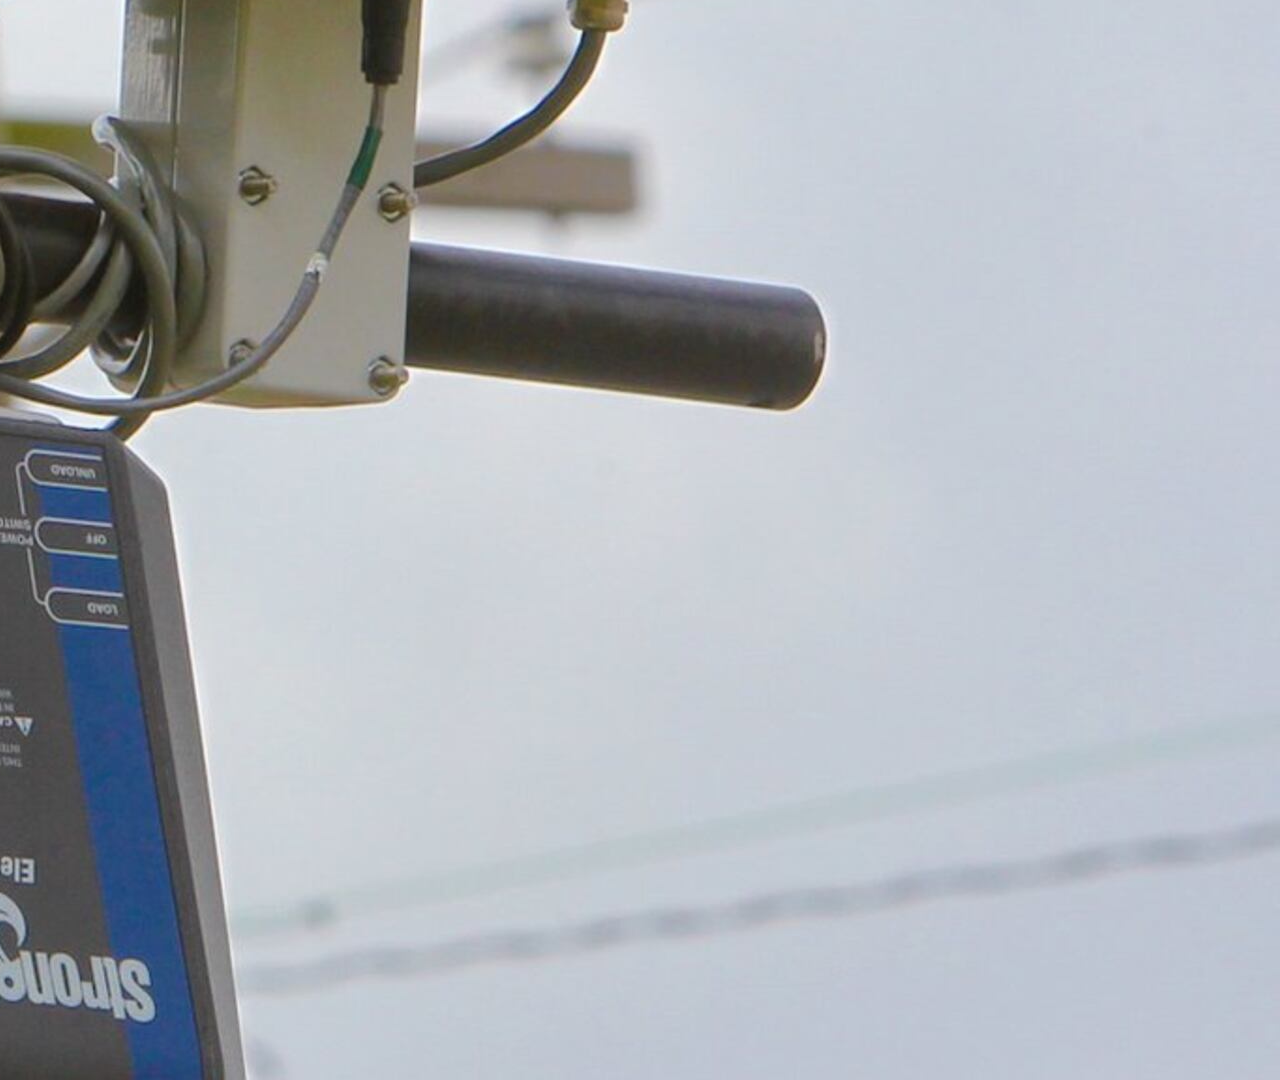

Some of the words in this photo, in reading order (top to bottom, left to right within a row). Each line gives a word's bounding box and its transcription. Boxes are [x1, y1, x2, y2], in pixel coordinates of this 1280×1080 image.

[50, 463, 96, 479] UNLOAD
[86, 533, 107, 545] OFF
[87, 602, 119, 616] LOAD
